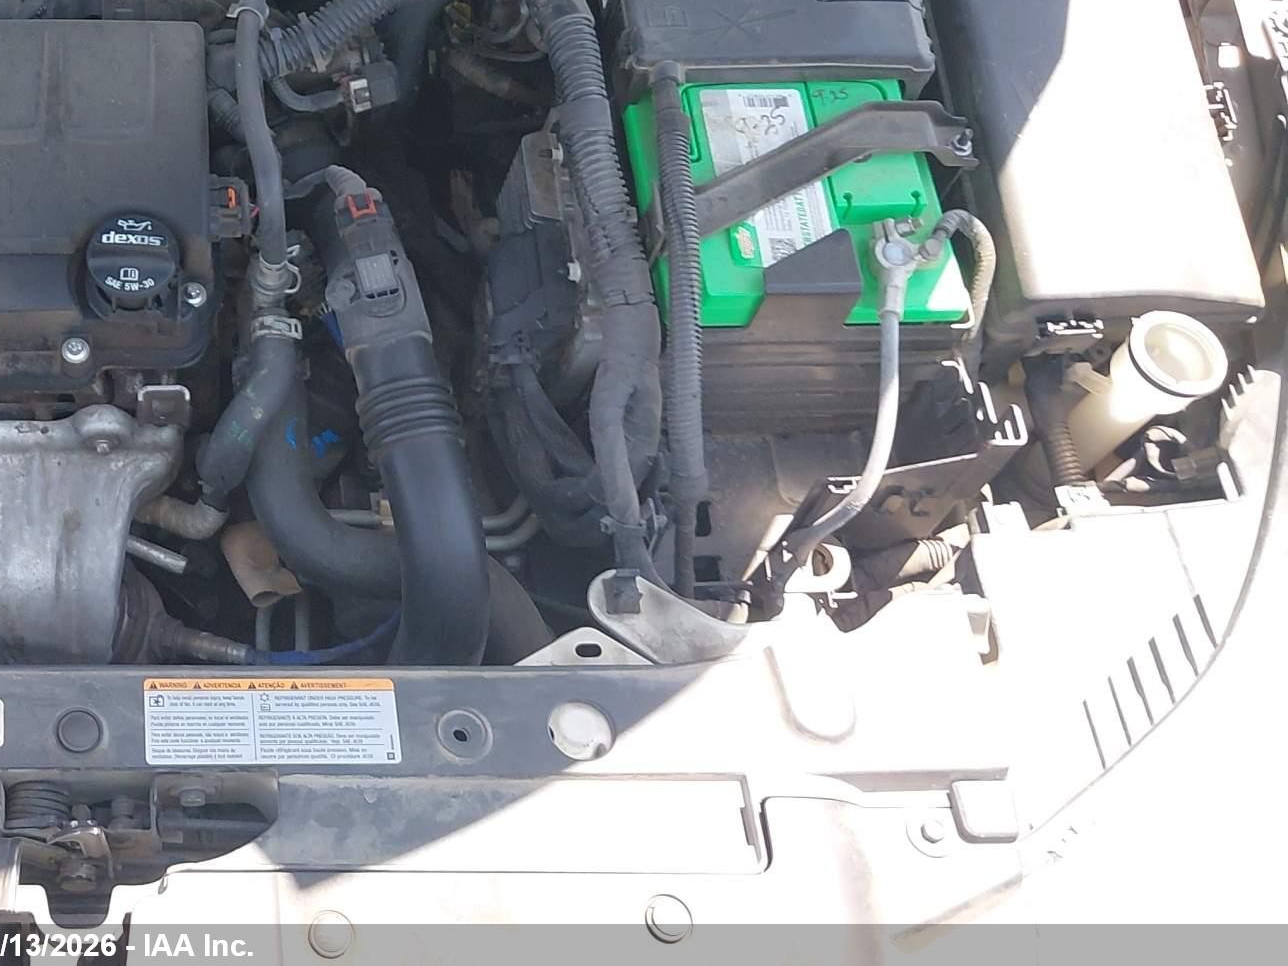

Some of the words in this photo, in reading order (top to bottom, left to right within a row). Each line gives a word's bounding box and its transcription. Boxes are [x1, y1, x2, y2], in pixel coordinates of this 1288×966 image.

[101, 231, 164, 246] dexos
[104, 276, 123, 290] SAE
[124, 278, 155, 291] 5W-30
